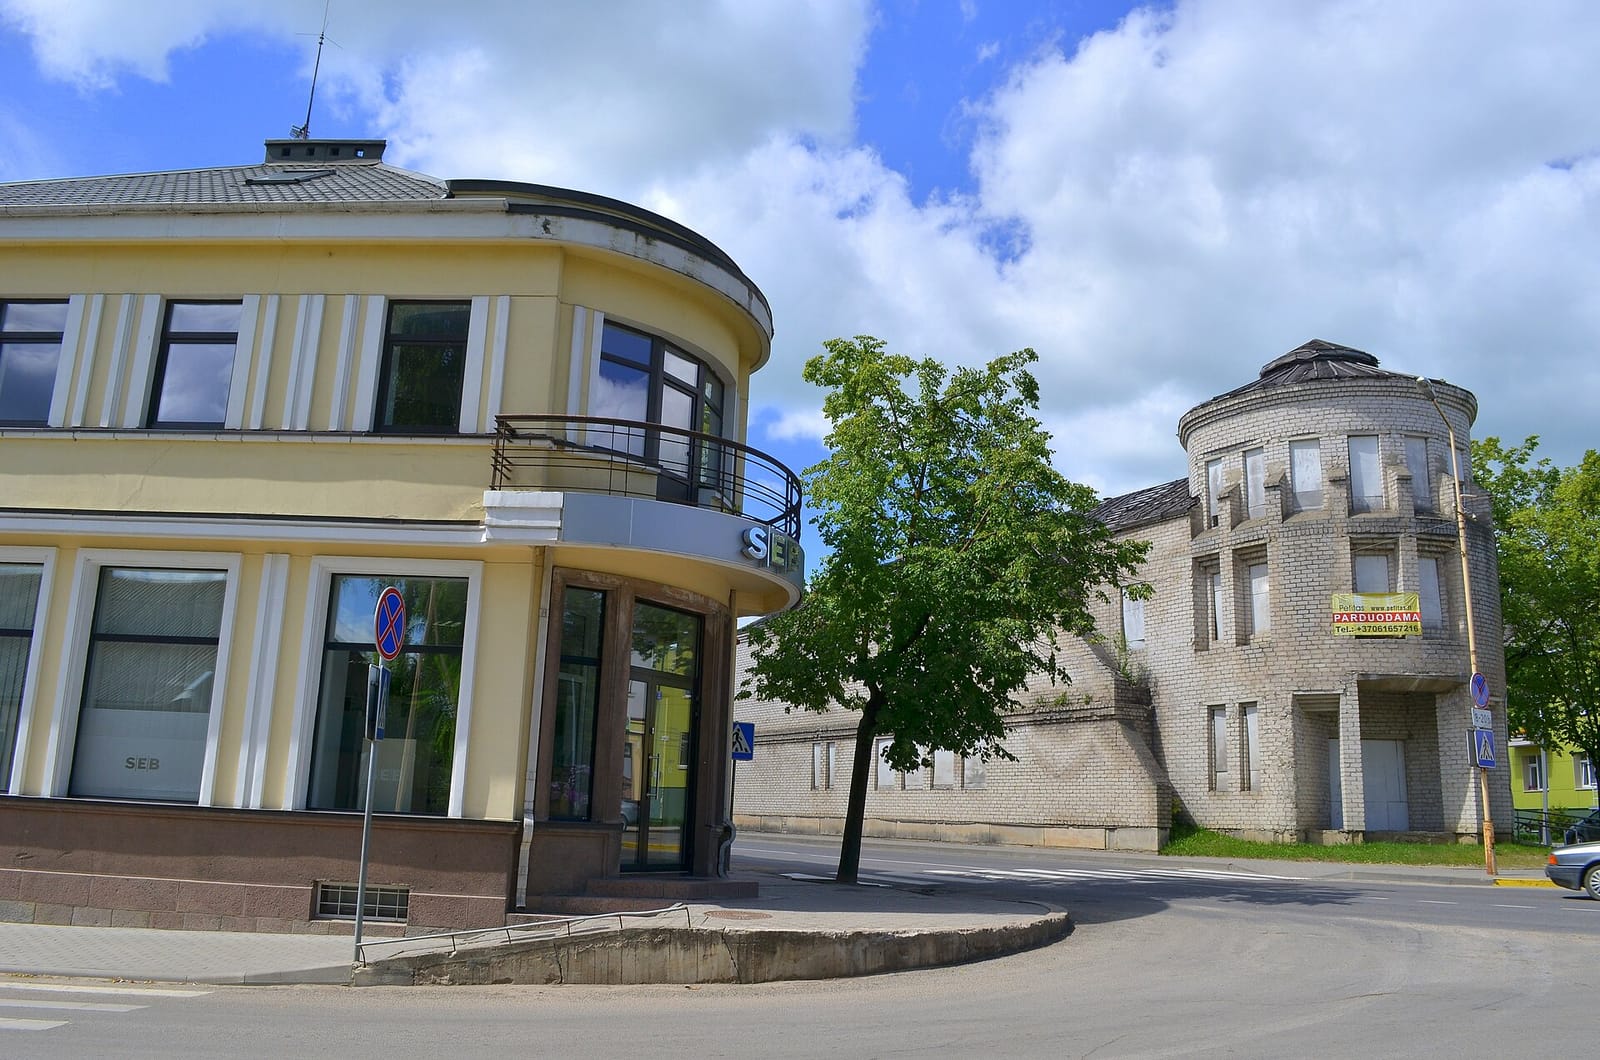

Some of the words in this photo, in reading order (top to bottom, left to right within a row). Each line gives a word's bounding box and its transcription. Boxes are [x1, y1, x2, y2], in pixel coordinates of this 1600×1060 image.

[1334, 613, 1420, 622] PARDUODAMA
[1335, 625, 1355, 633] Tel.:
[125, 757, 160, 769] SEB
